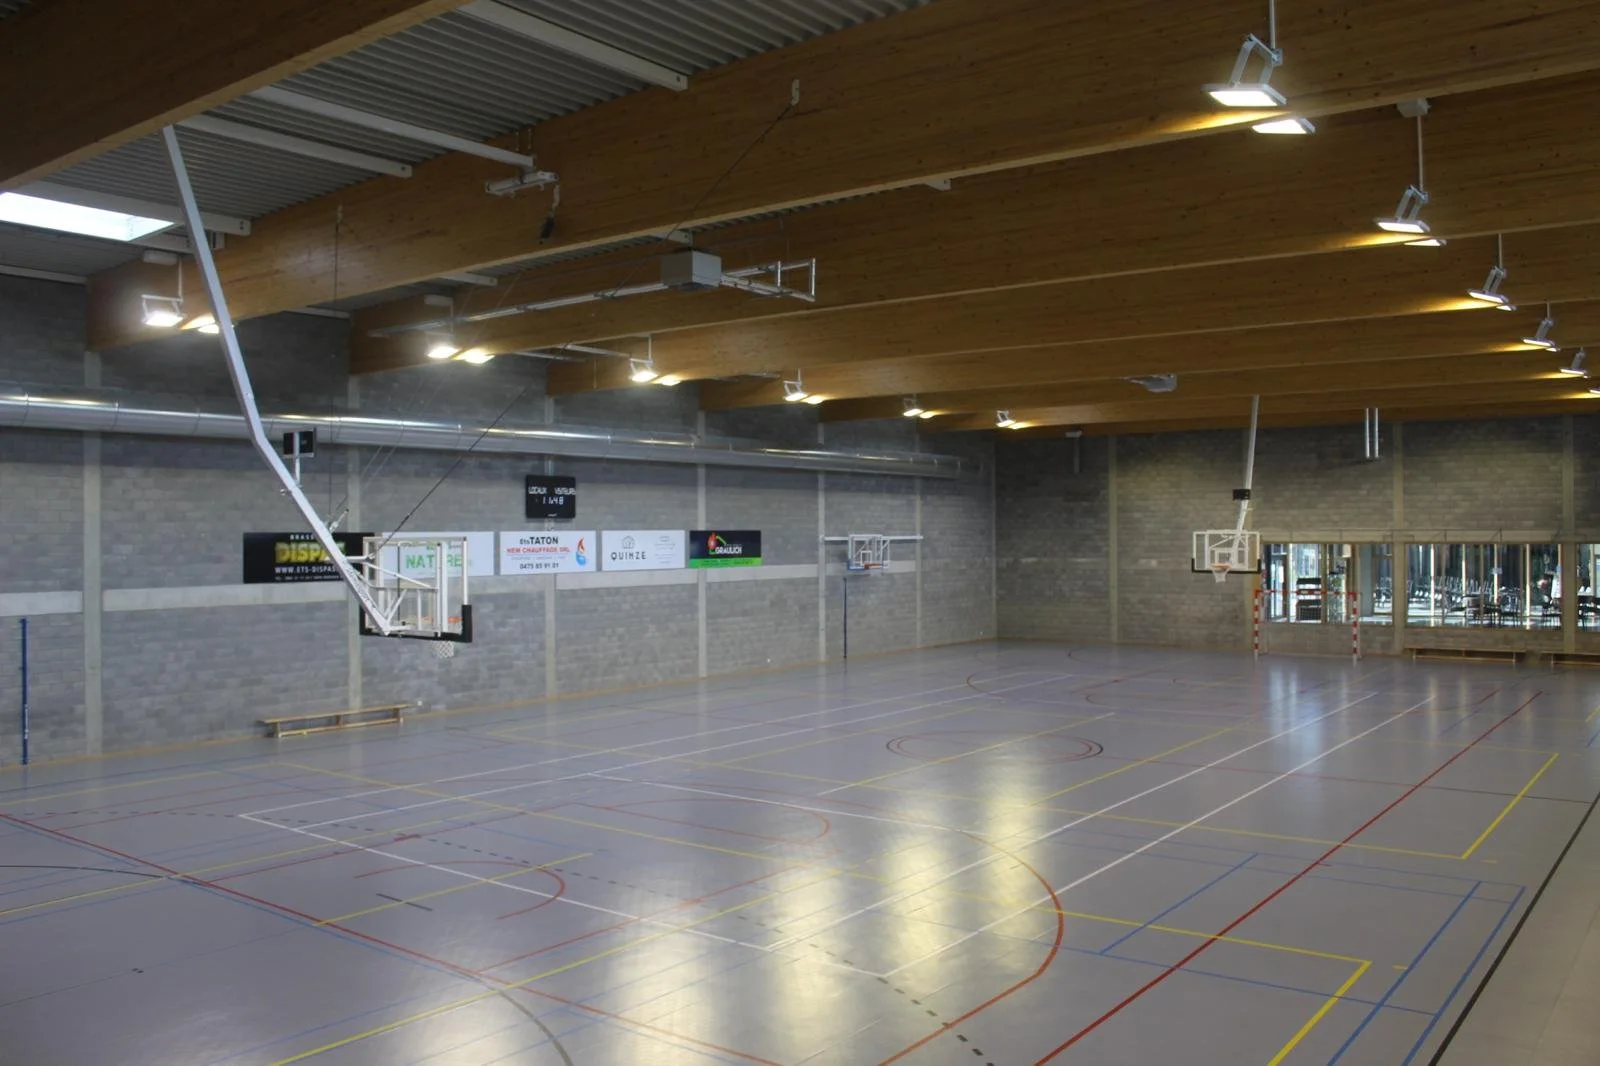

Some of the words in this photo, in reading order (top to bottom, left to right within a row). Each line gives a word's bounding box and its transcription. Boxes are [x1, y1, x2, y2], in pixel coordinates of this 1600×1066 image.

[275, 541, 345, 563] DISPA
[610, 551, 647, 561] QUINZE
[406, 554, 462, 569] NATRE
